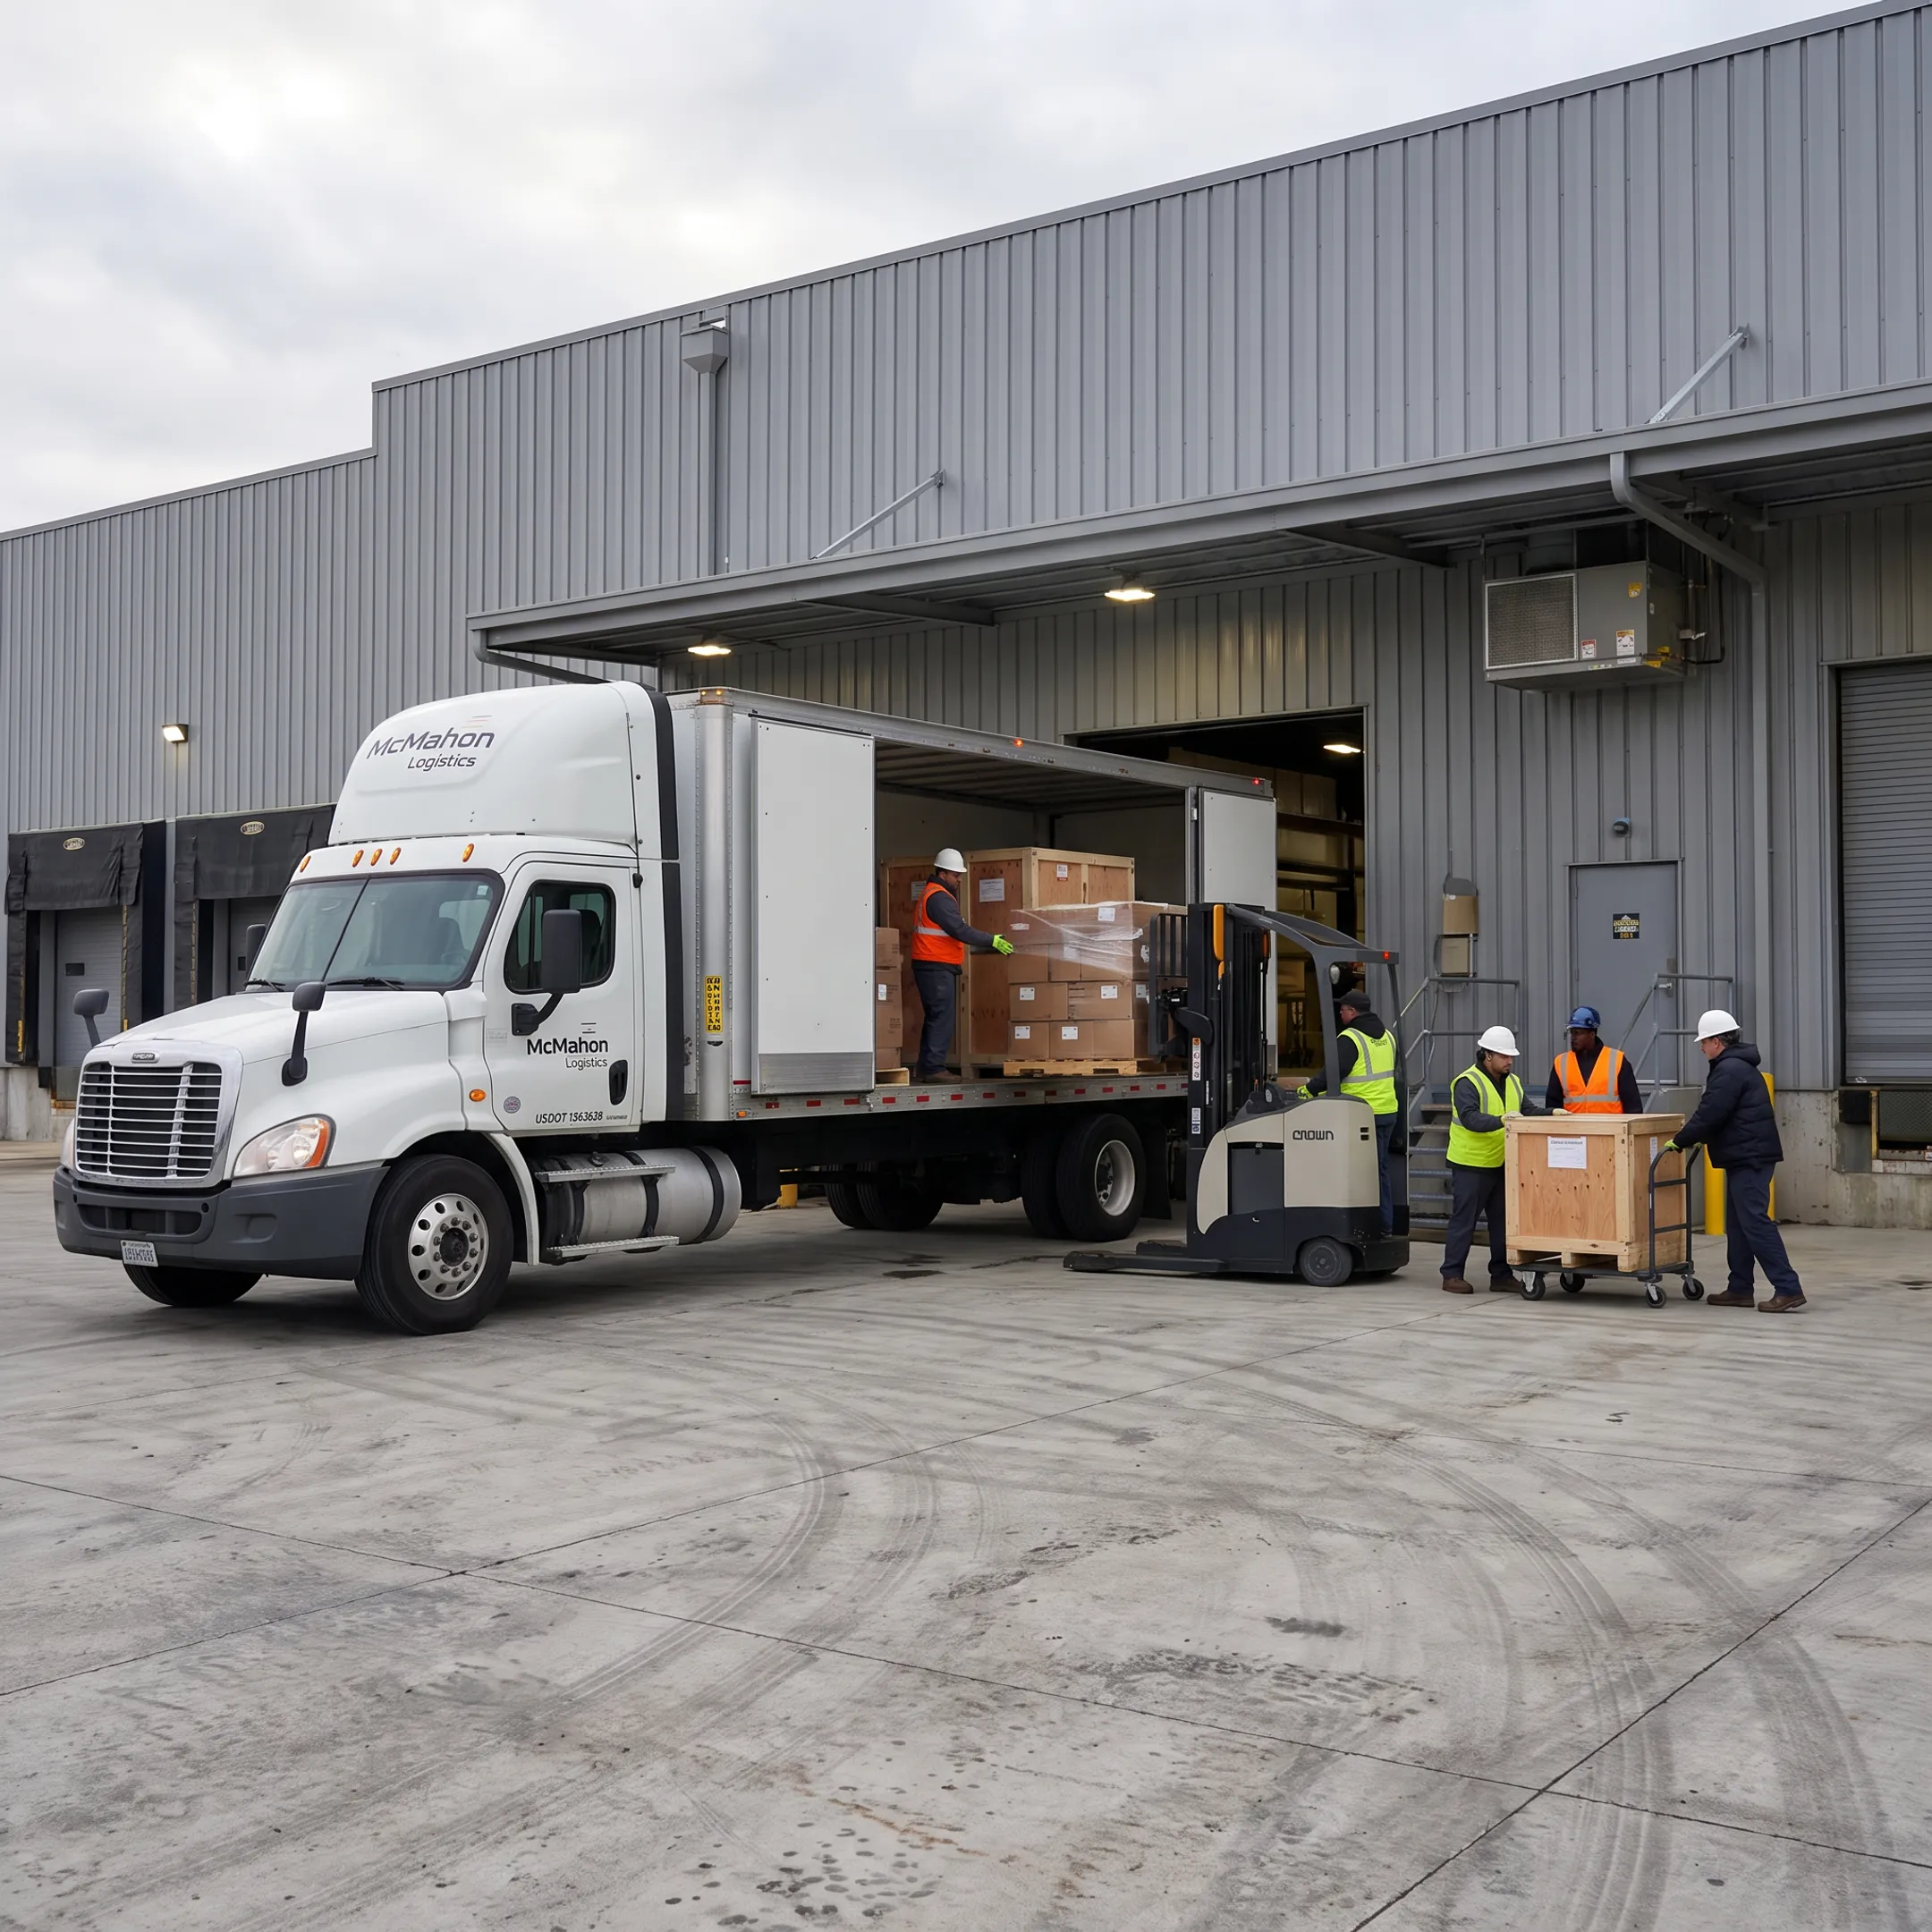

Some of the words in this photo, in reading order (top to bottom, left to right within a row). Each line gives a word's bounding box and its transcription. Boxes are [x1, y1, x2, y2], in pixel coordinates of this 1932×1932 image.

[367, 727, 495, 758] McMahon
[407, 754, 477, 772] Logistics
[527, 1037, 608, 1055] McMahon
[564, 1056, 608, 1071] Logistics
[536, 1113, 568, 1124] USDOT
